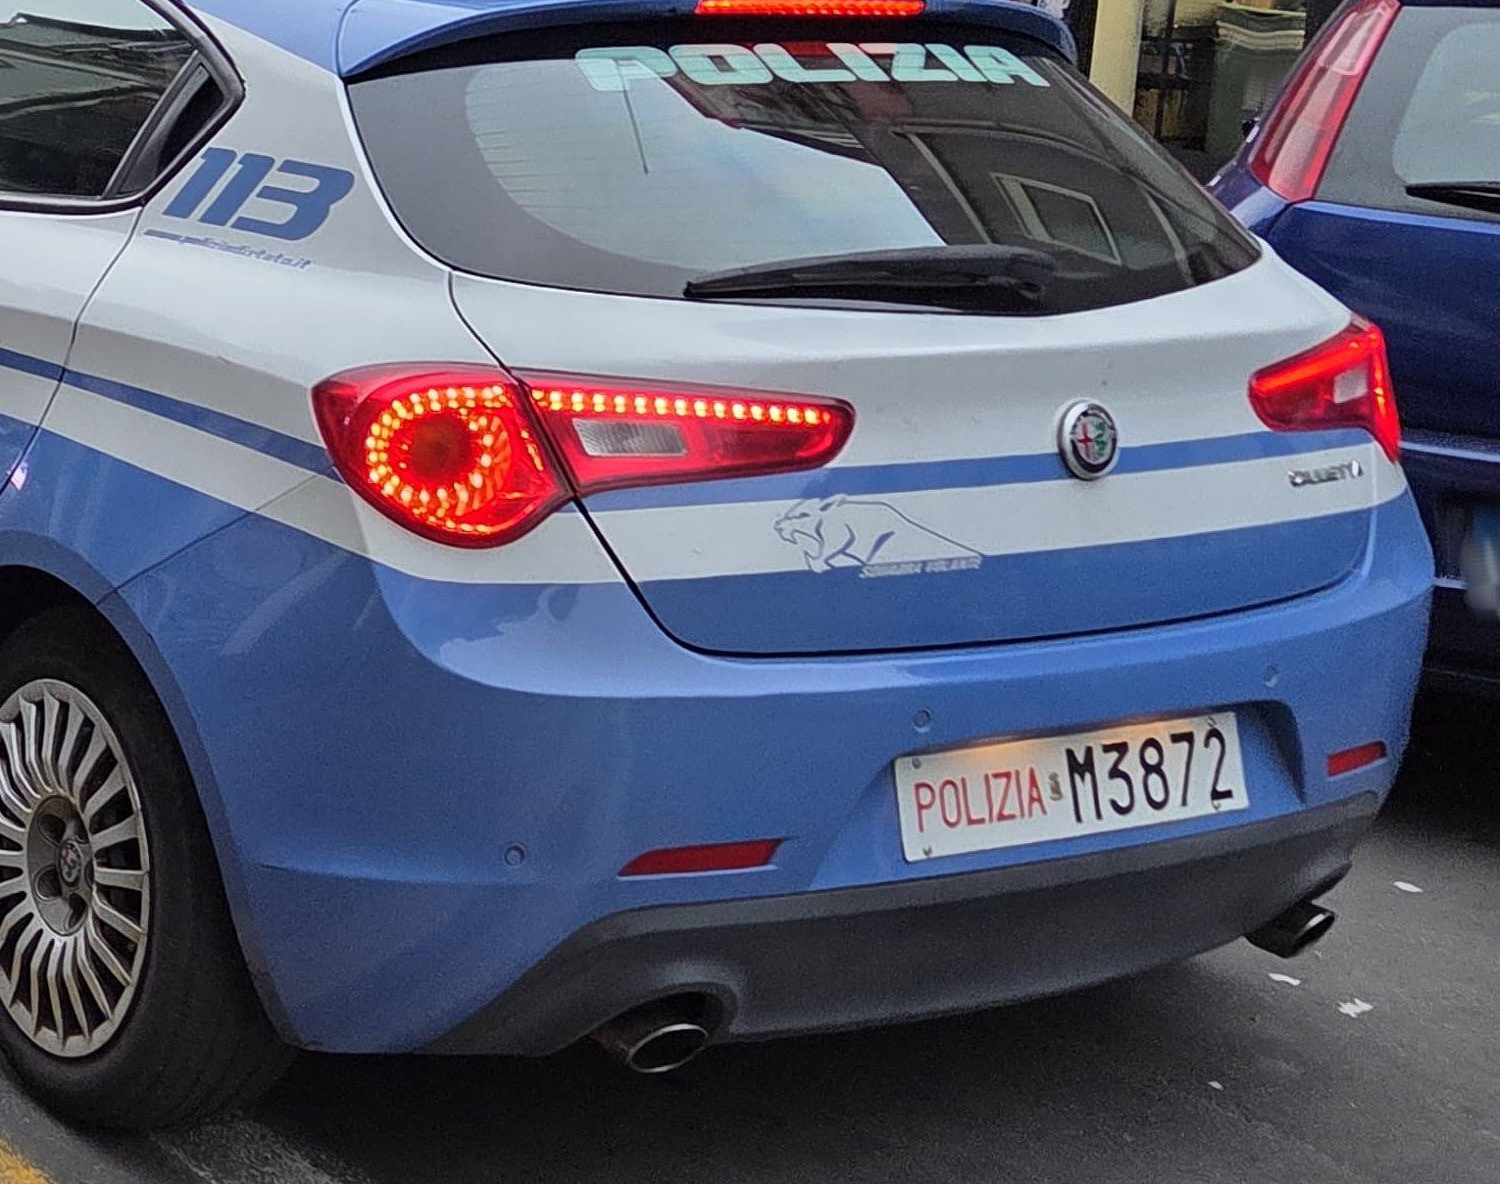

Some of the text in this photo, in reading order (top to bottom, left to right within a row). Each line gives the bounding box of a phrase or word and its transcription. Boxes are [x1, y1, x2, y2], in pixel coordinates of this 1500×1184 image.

[575, 42, 1051, 93] POLIZIA
[162, 146, 356, 242] 113
[912, 727, 1234, 833] POLIZIA M3872
